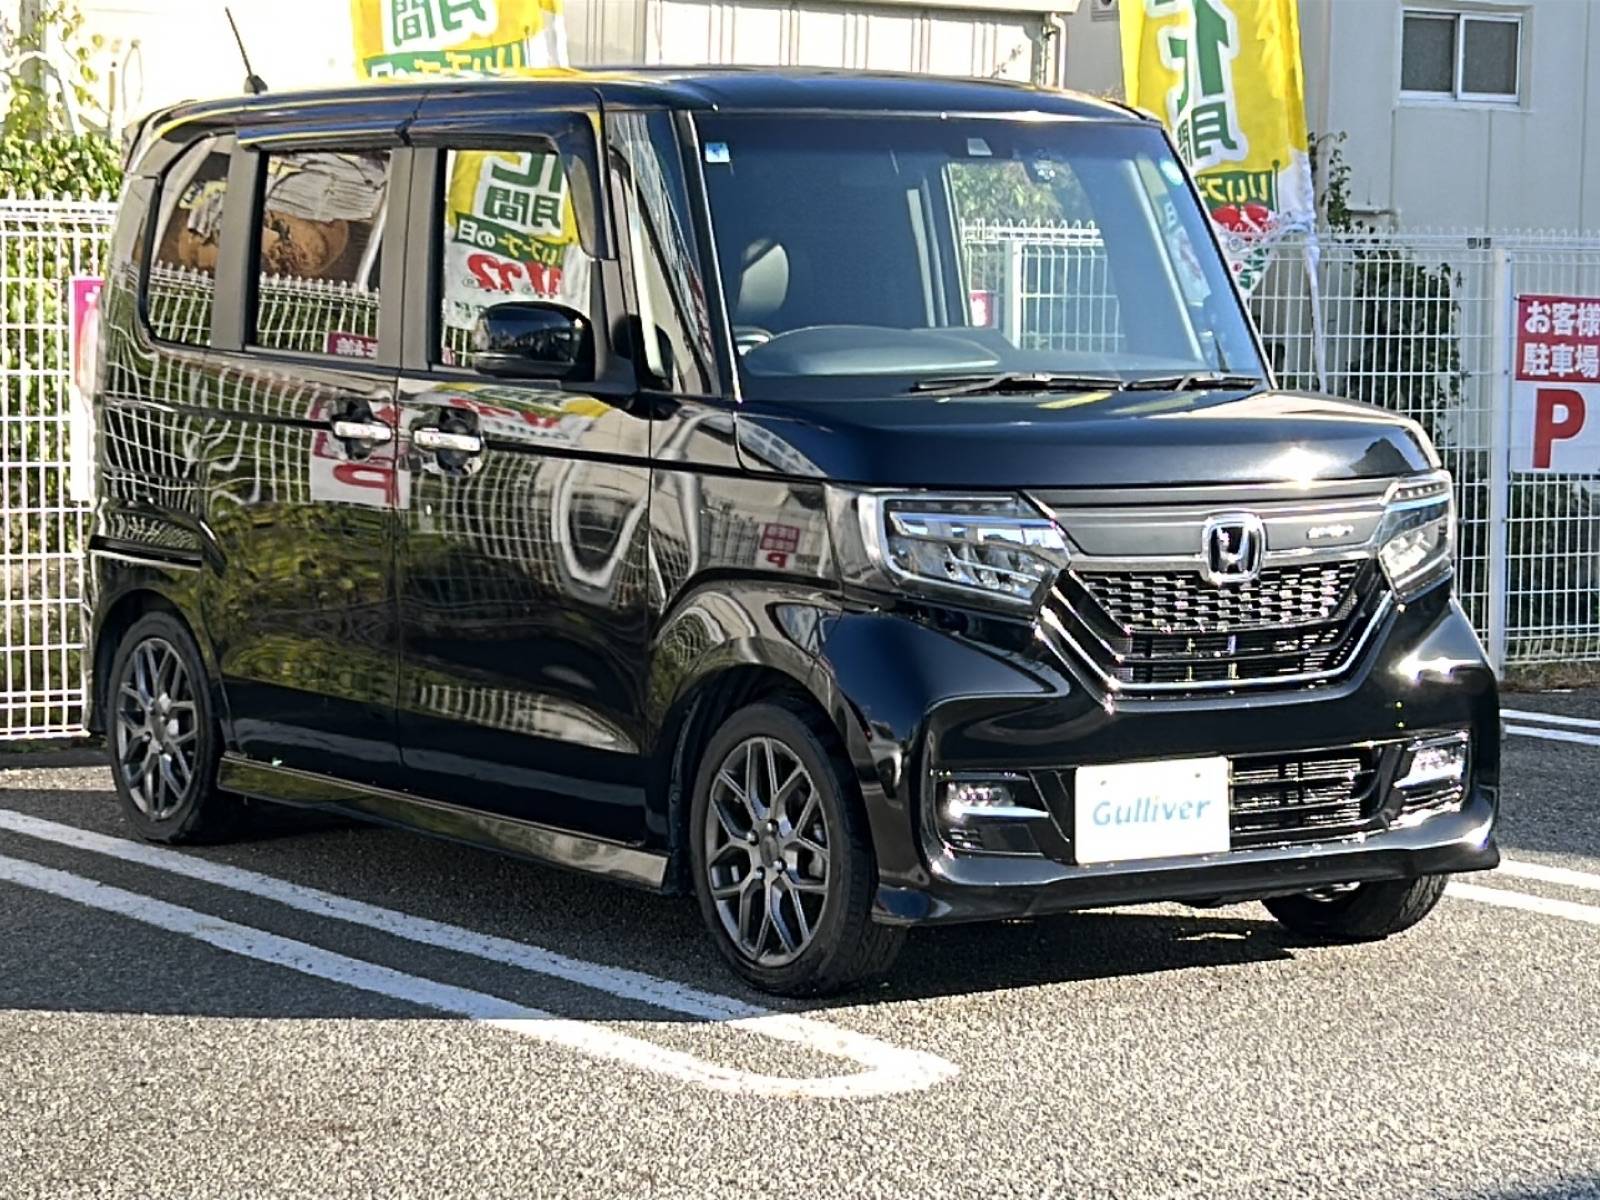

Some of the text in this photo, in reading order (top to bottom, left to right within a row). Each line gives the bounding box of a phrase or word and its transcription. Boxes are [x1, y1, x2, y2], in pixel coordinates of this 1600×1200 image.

[1524, 300, 1600, 337] お客様
[1522, 343, 1599, 378] 駐車場
[1532, 388, 1586, 469] P
[1092, 796, 1212, 827] Gulliver
